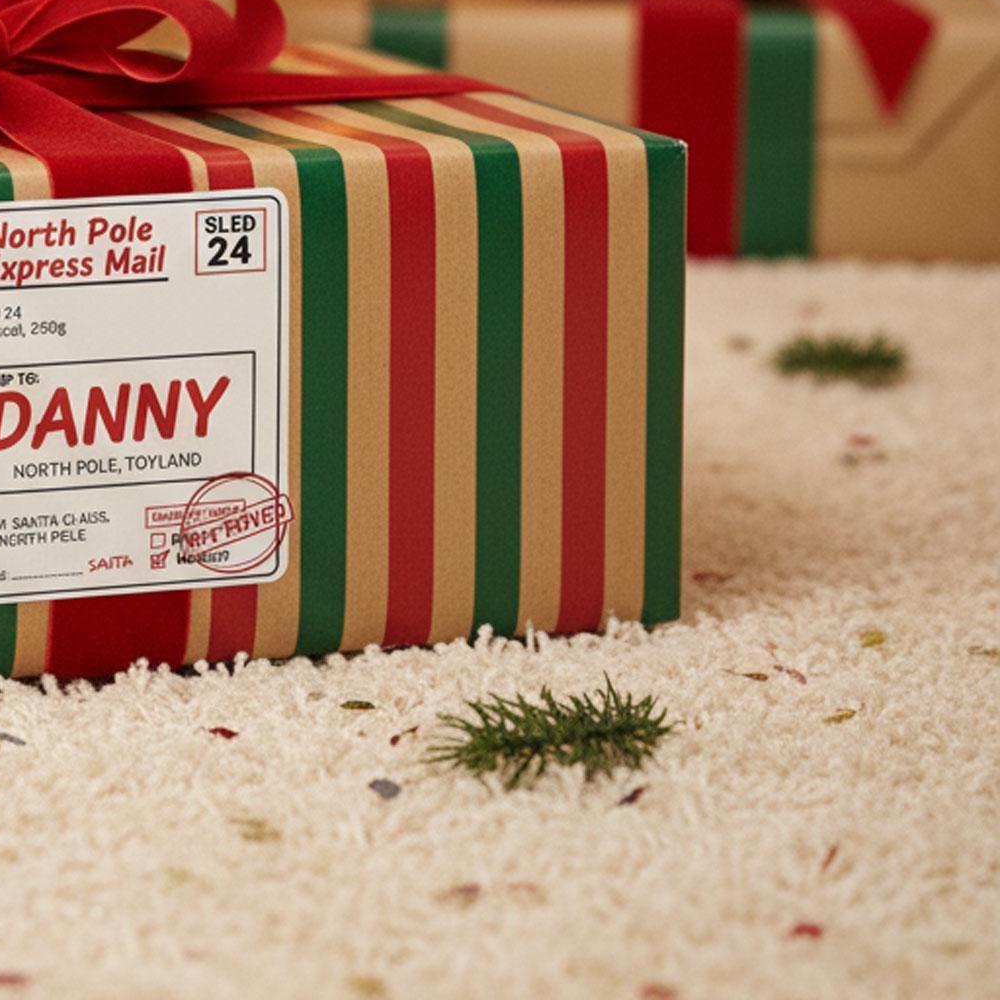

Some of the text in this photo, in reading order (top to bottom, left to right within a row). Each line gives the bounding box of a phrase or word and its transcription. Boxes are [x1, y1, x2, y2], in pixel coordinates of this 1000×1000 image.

[88, 215, 153, 246] Pole
[204, 216, 257, 234] SLED
[104, 244, 167, 277] Mail
[207, 236, 253, 267] 24
[4, 305, 22, 320] 24
[13, 451, 203, 480] NORTH POLE, TOYLAND
